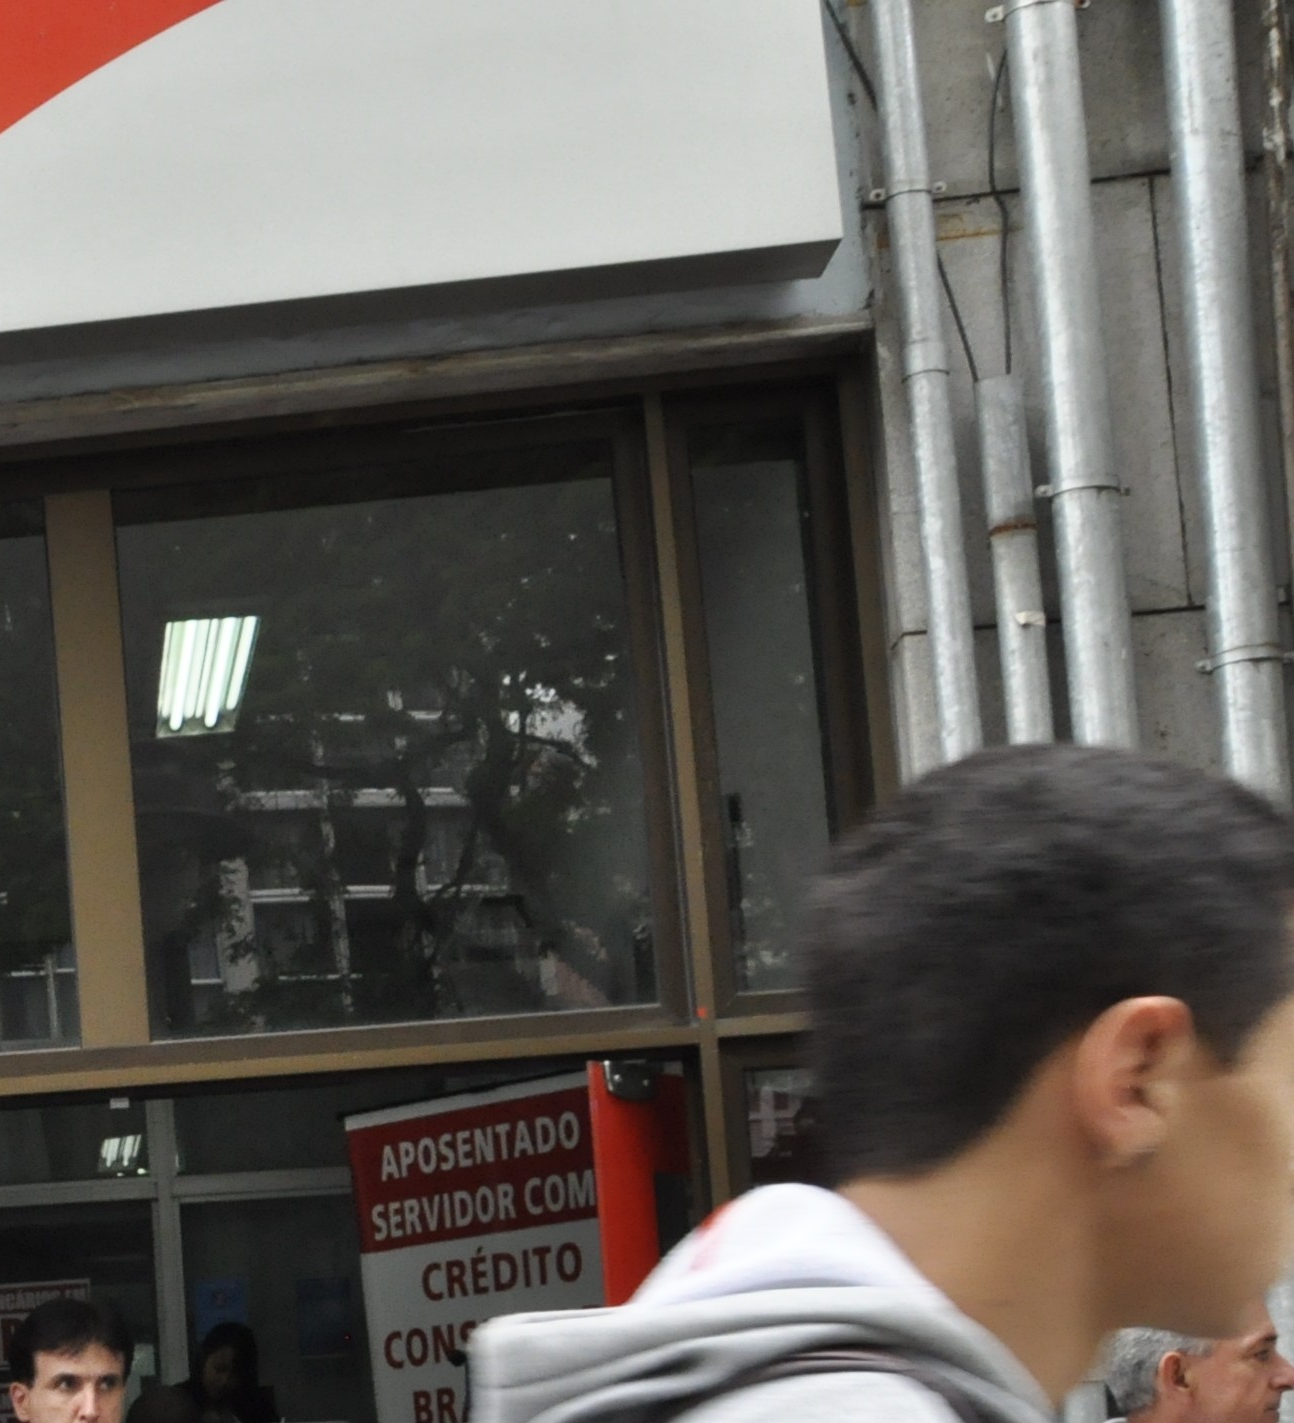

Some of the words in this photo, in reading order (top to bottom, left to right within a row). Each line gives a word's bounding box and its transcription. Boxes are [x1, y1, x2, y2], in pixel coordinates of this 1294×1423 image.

[381, 1111, 580, 1181] APOSENTADO
[371, 1183, 516, 1241] SERVIDOR
[524, 1169, 596, 1215] COM
[422, 1242, 582, 1301] CRÉDITO
